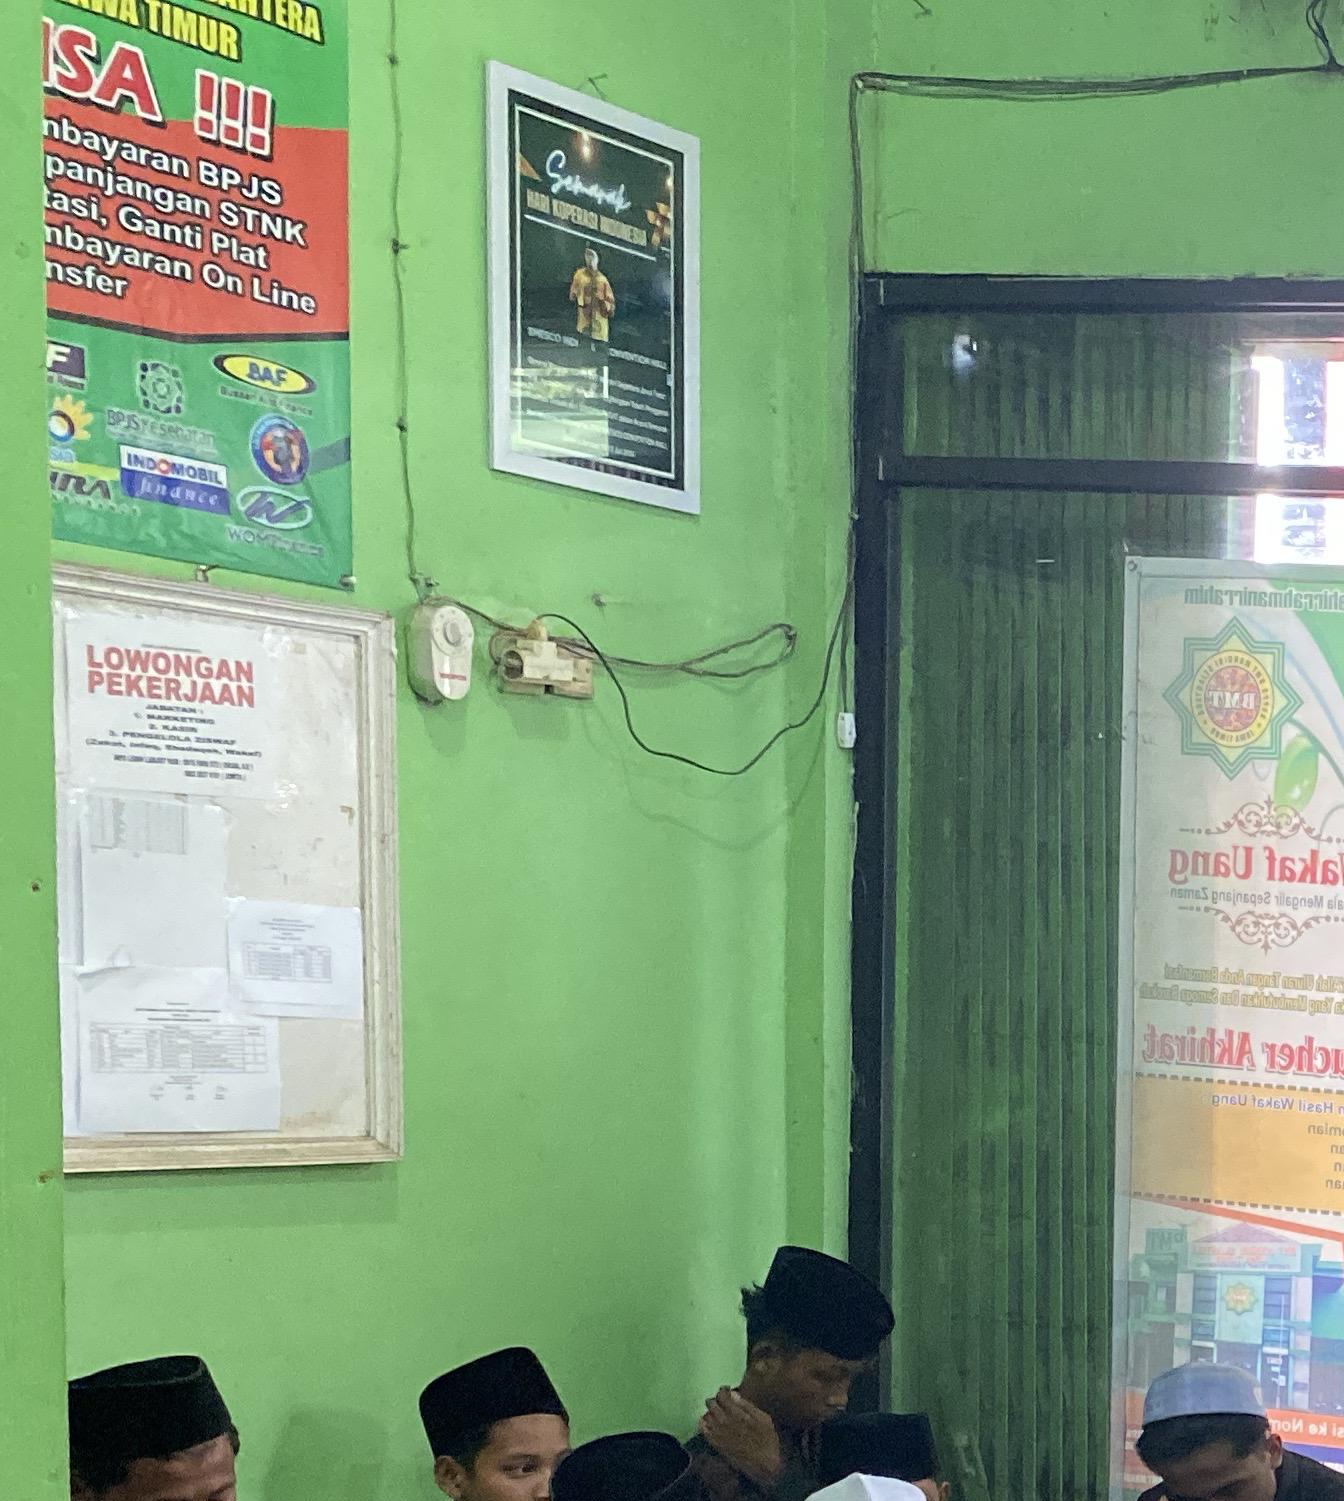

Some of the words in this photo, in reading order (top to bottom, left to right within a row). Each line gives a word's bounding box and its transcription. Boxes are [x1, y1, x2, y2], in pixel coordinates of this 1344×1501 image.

[198, 160, 282, 205] BPJS
[119, 204, 202, 250] Ganti
[210, 231, 269, 269] Plat
[218, 201, 307, 248] STNK
[201, 263, 244, 294] On
[252, 277, 316, 314] Line
[86, 644, 254, 684] LOWONGAN
[87, 670, 255, 709] PEKERJAAN
